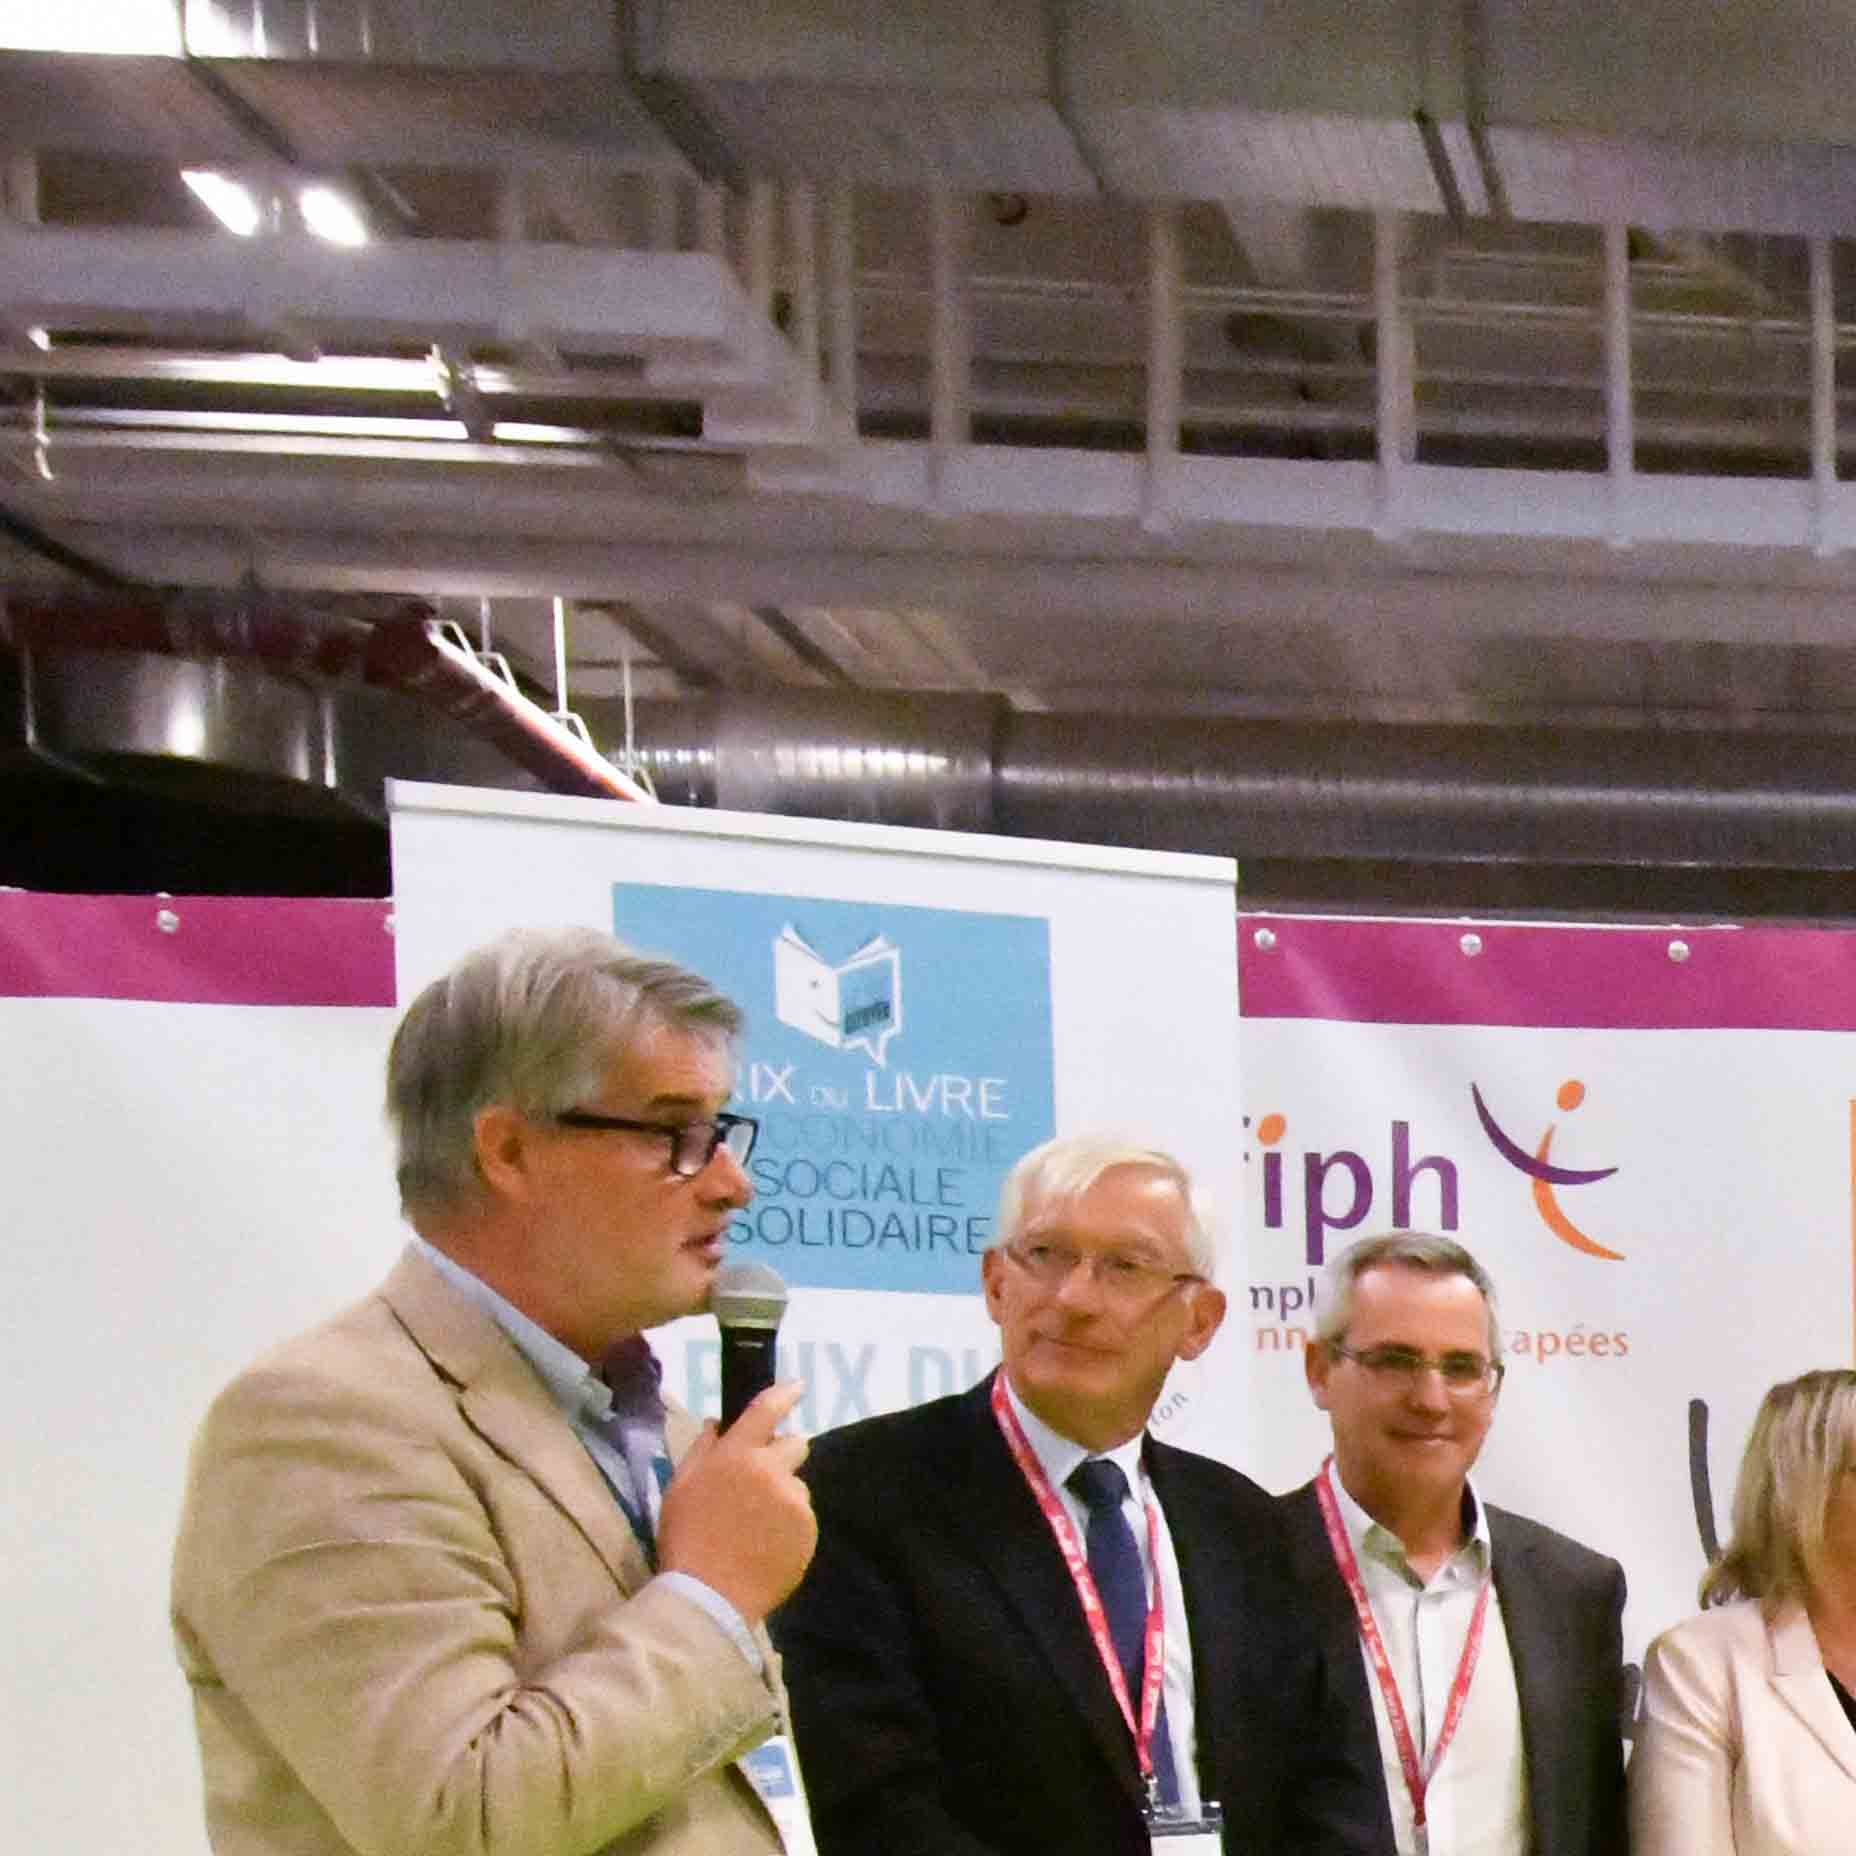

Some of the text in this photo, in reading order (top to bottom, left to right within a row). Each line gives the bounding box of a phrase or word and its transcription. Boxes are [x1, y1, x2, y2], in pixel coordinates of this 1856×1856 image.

[865, 1069, 1010, 1120] LIVRE
[751, 1157, 966, 1208] SOCIALE
[1243, 1112, 1459, 1266] iph
[726, 1205, 992, 1255] SOLIDAIRE
[1502, 1322, 1631, 1368] apées
